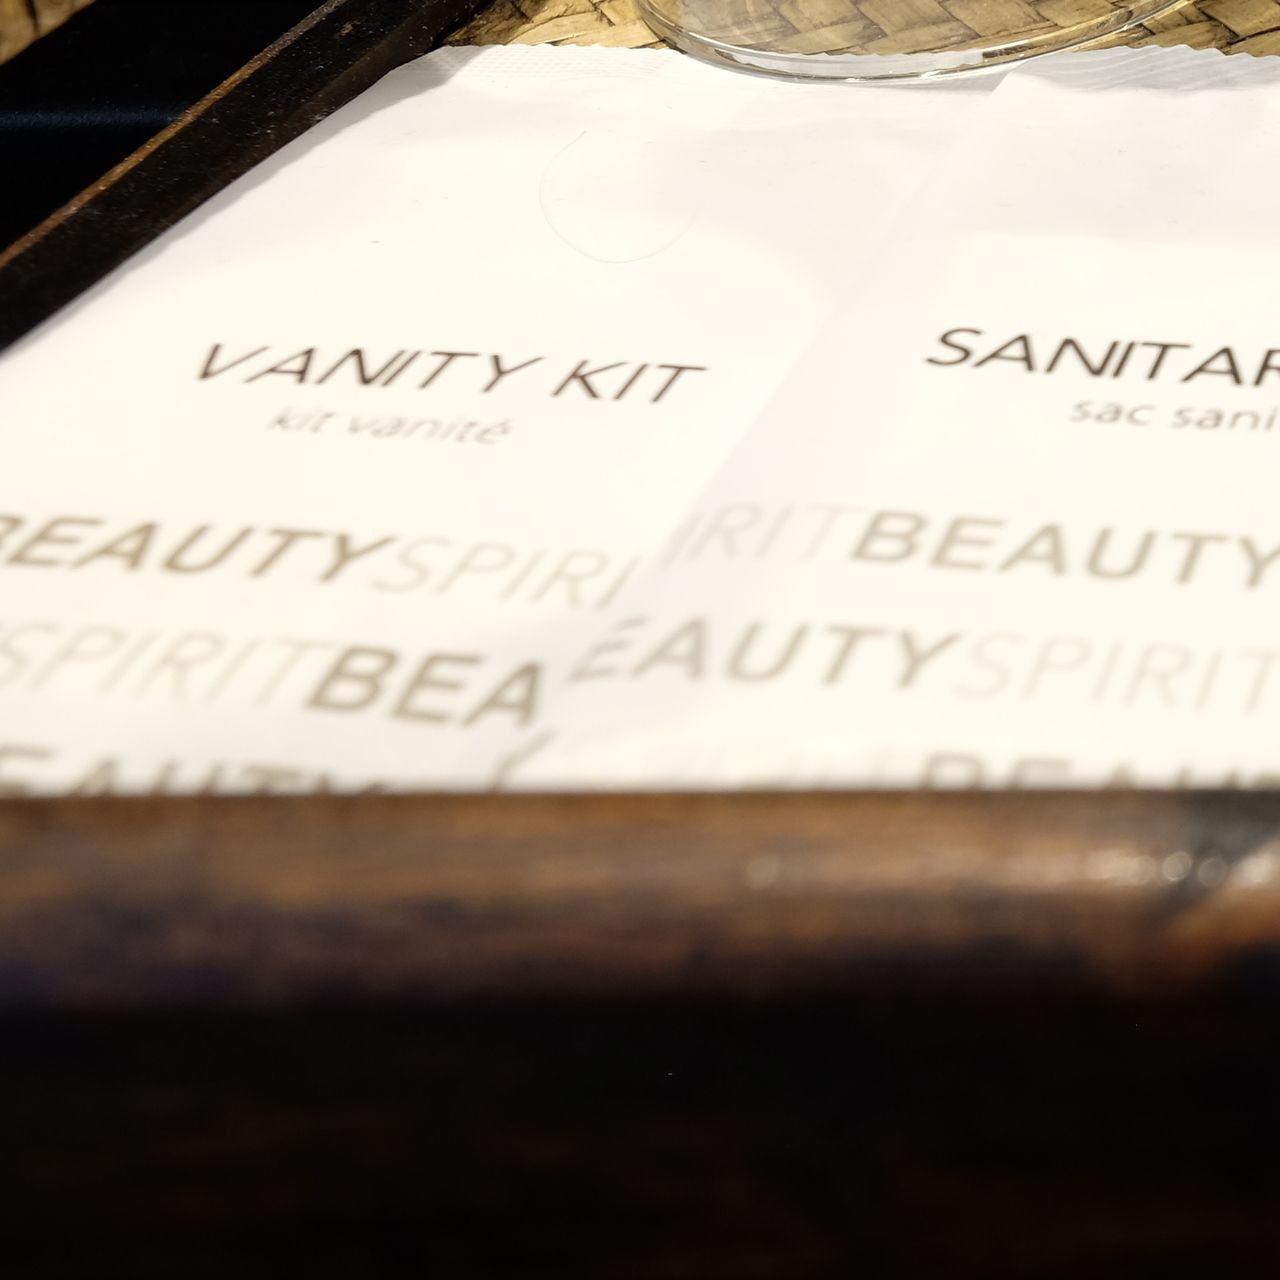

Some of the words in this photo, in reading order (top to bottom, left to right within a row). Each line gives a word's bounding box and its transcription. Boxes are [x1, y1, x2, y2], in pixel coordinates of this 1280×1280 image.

[194, 341, 547, 394] VANITY
[550, 358, 709, 404] KIT
[266, 403, 337, 434] kit
[1068, 399, 1156, 426] sac
